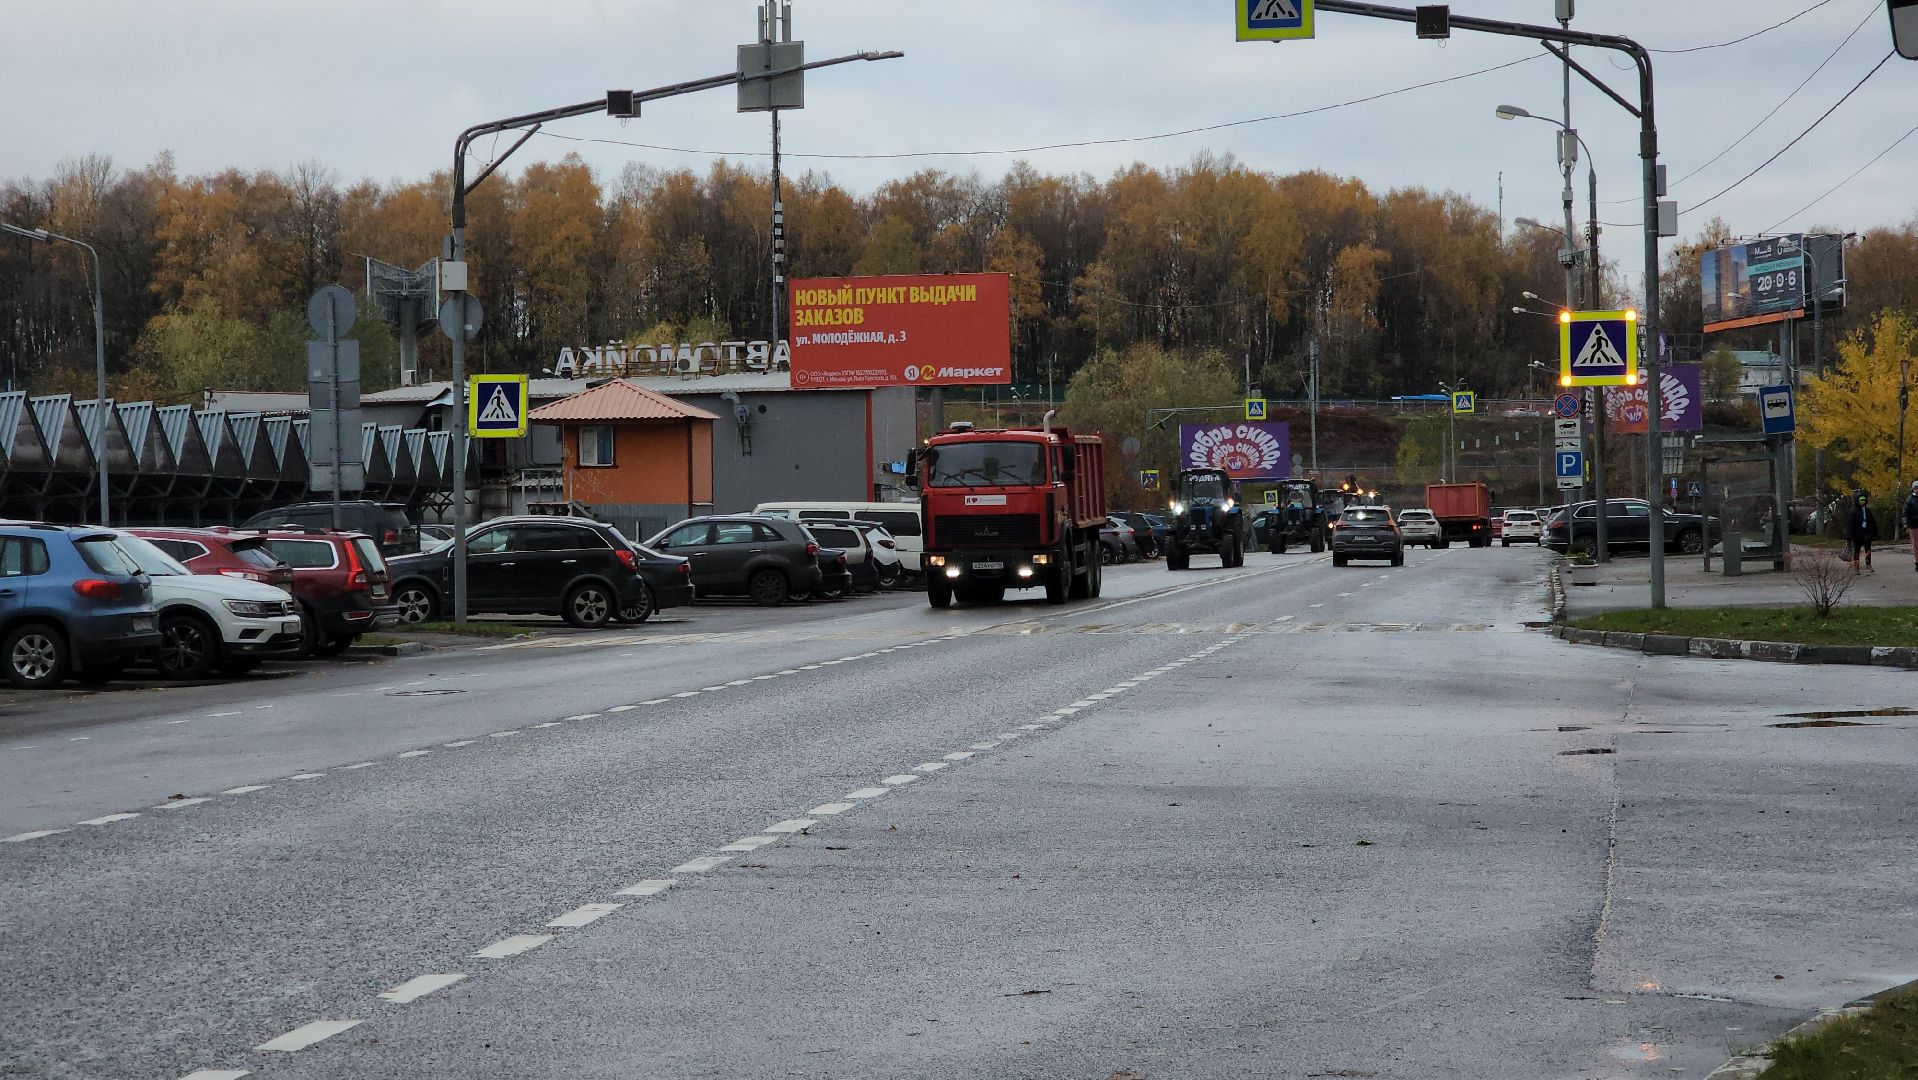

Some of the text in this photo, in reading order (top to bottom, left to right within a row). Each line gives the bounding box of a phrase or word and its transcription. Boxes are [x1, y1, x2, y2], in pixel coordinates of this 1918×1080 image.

[795, 284, 977, 306] НОВЫЙ ПУНКТ ВЫДАЧИ
[795, 307, 865, 327] ЗАКАЗОВ
[795, 336, 811, 347] ул.
[899, 330, 907, 342] 3
[937, 366, 1004, 379] Маркет
[1562, 454, 1576, 475] P
